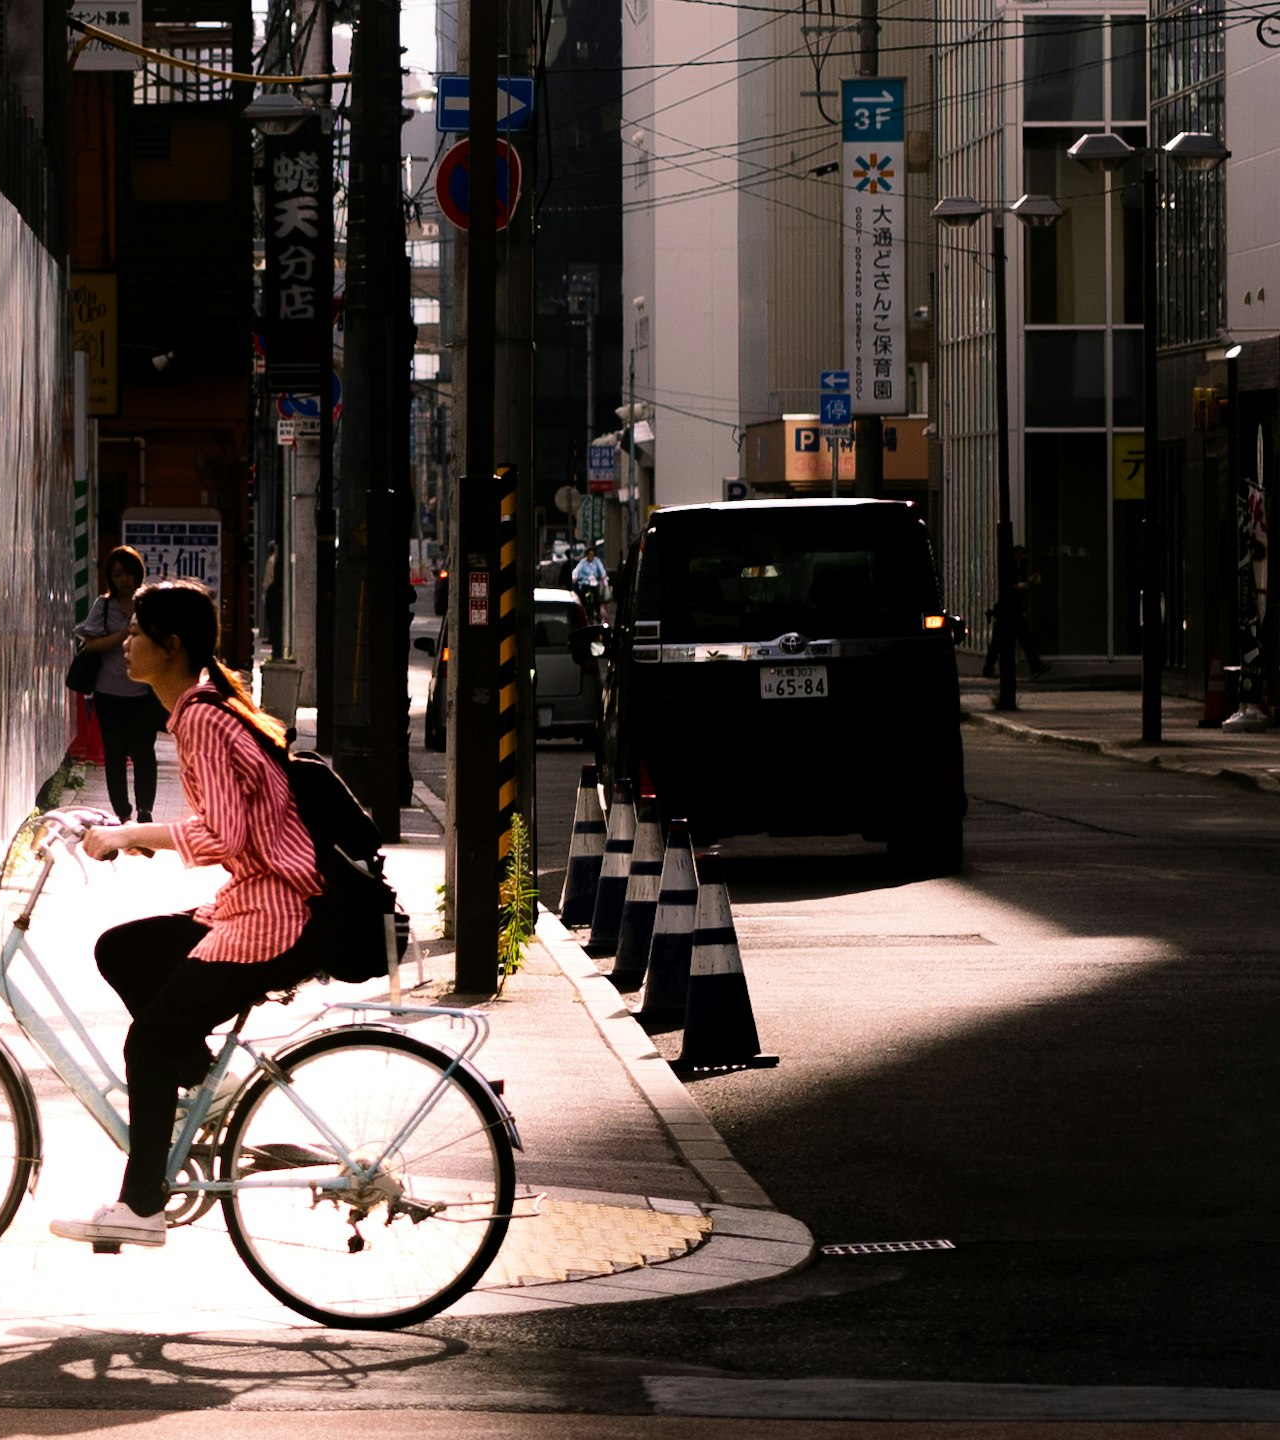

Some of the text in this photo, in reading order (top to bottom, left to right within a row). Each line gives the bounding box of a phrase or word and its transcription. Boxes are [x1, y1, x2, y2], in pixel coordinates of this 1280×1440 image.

[853, 107, 893, 132] 3F
[872, 203, 893, 400] 大通どさんこ保育園
[824, 399, 847, 421] 停
[775, 677, 825, 696] 65-84
